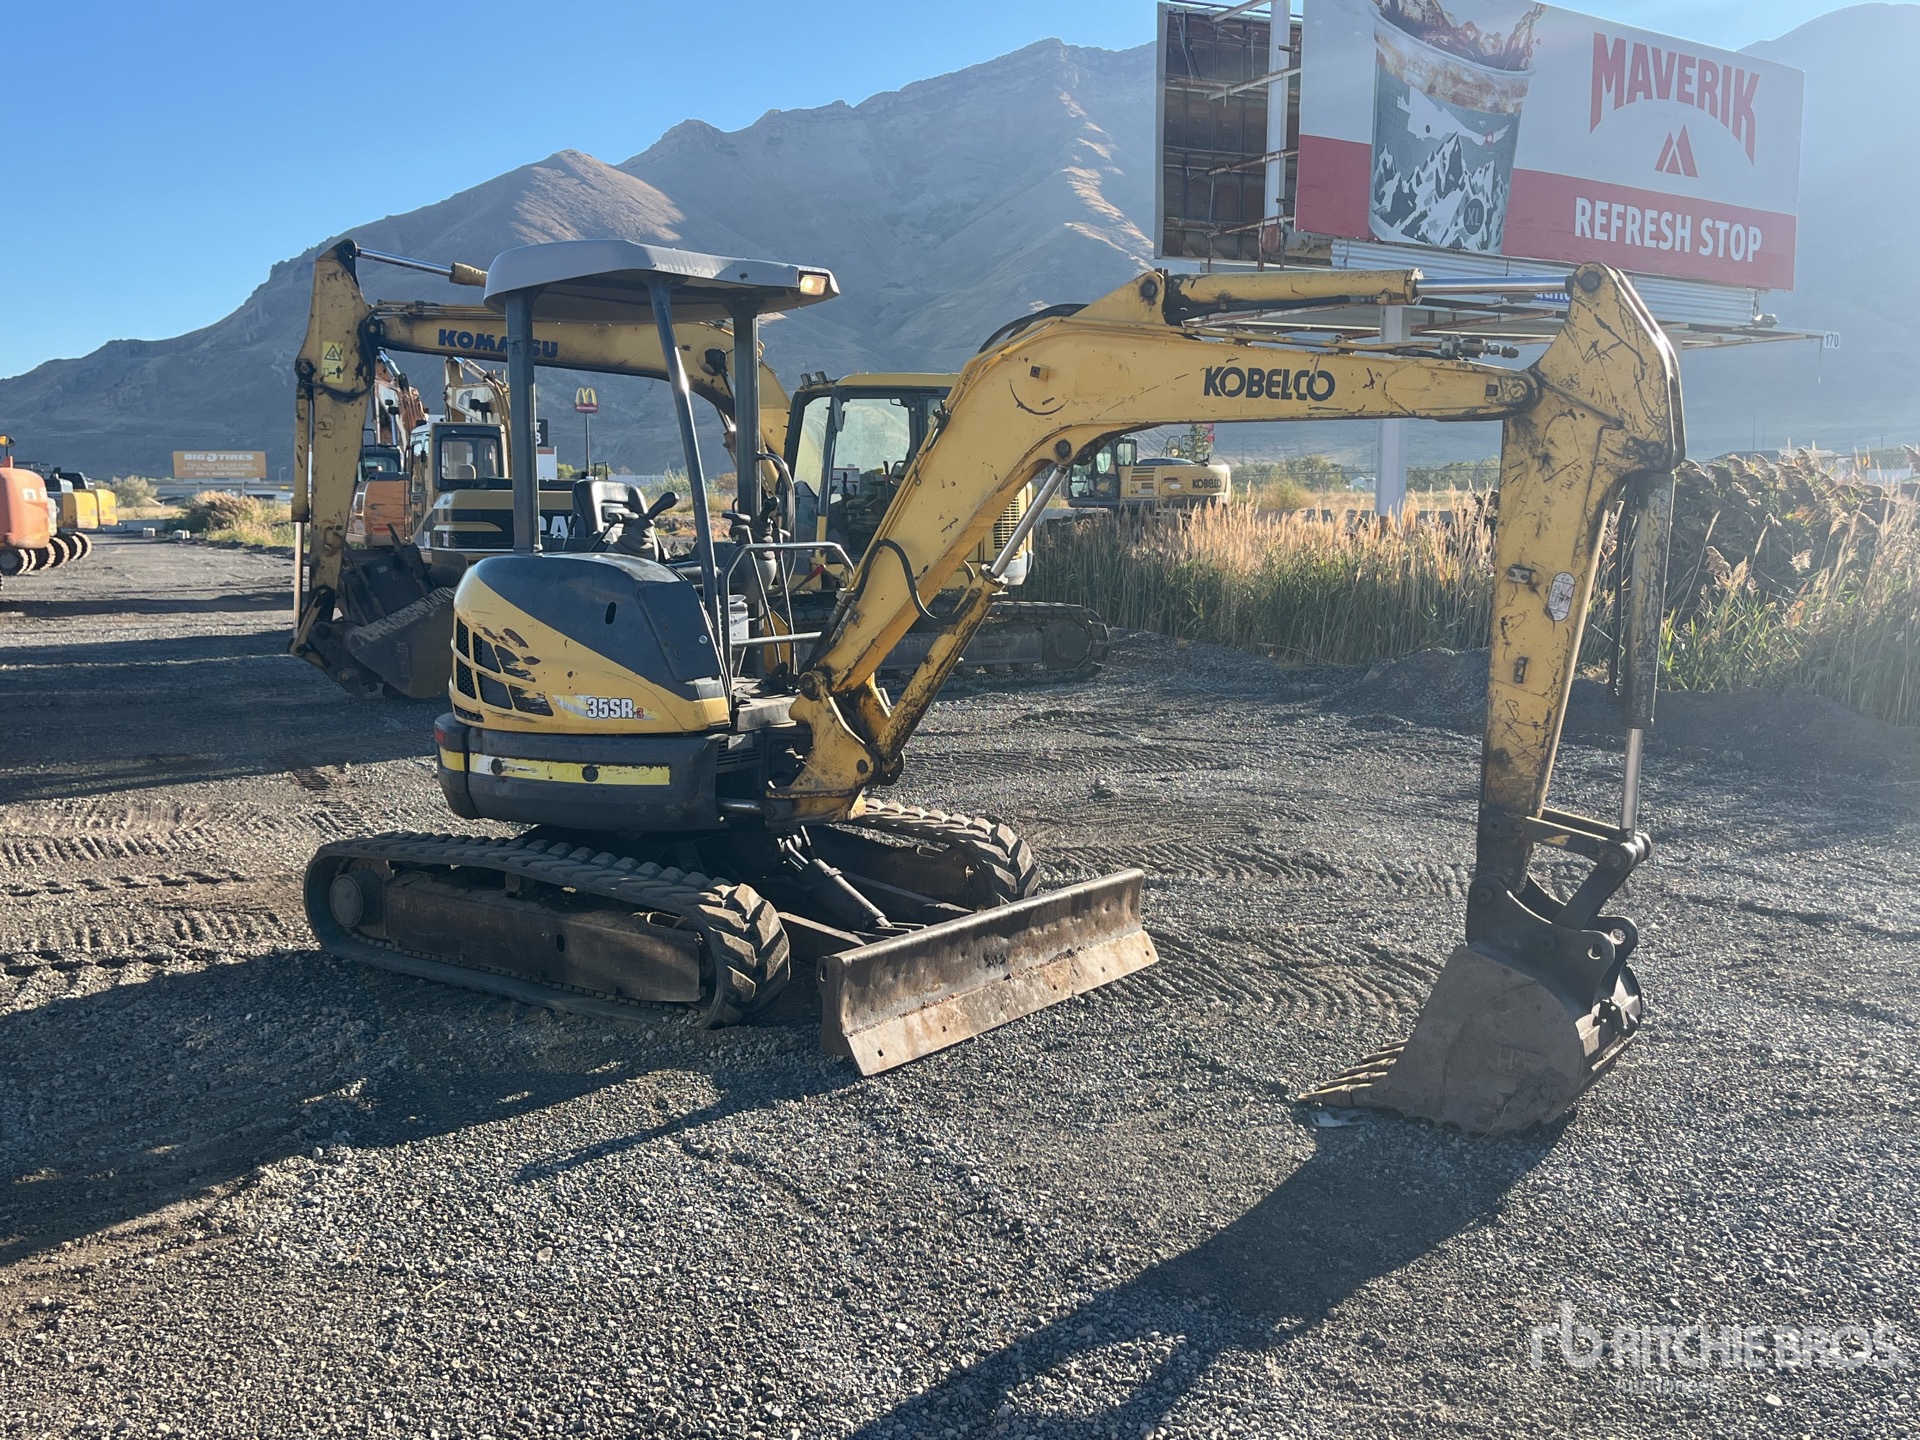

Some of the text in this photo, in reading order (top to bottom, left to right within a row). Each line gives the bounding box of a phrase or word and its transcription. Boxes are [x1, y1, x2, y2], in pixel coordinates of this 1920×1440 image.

[1590, 32, 1760, 167] MAVERIK
[1466, 207, 1481, 226] XL
[1574, 197, 1763, 262] REFRESH STOP
[1826, 334, 1839, 347] 170
[1203, 366, 1336, 402] KOBELCO
[1192, 478, 1222, 489] KOBELCO
